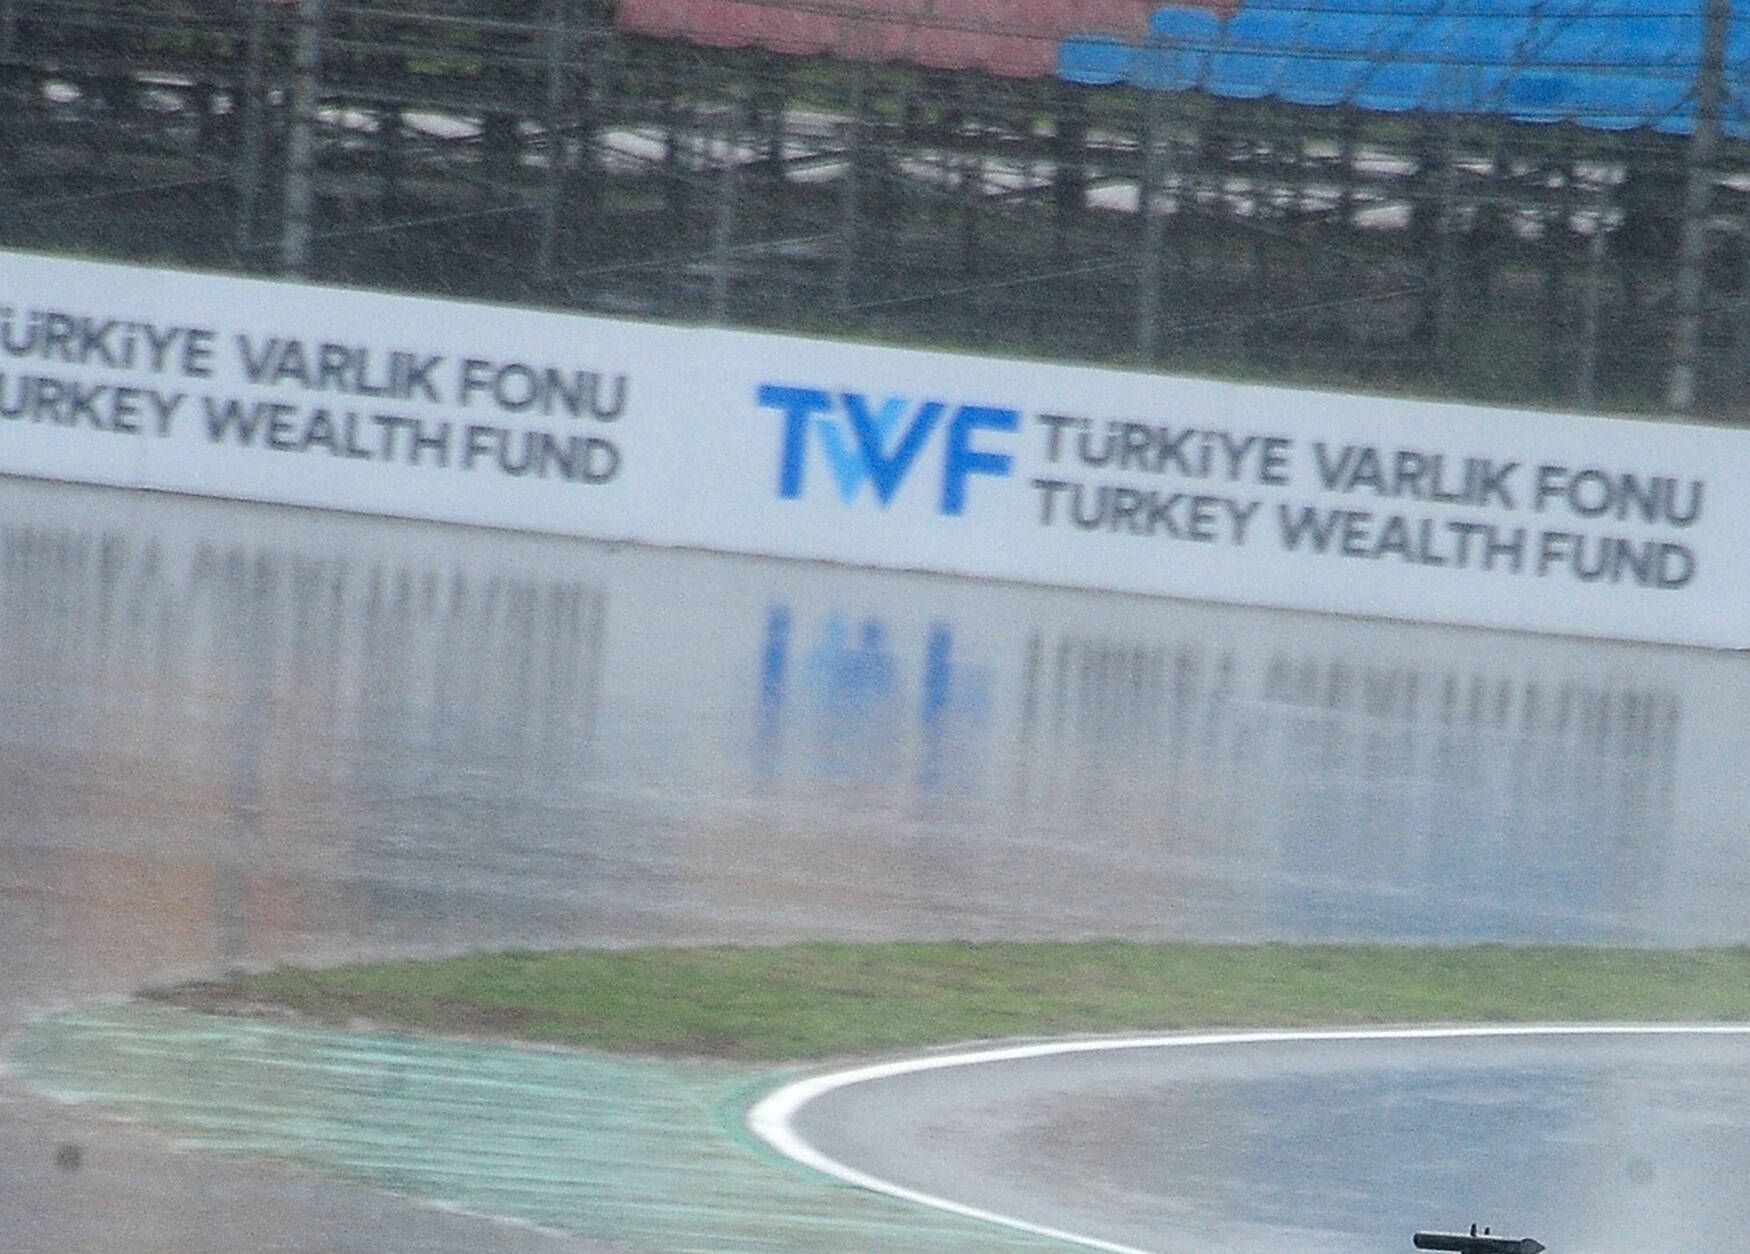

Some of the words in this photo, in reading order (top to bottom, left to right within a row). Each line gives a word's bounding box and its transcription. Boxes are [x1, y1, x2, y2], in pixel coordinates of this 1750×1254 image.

[0, 371, 186, 437] URKEY
[202, 396, 450, 468] WEALTH
[463, 425, 621, 486] FUND
[236, 333, 444, 403] VARLIK
[459, 358, 627, 423] FONU
[1032, 478, 1261, 546] TURKEY
[1278, 503, 1525, 574] WEALTH
[1537, 530, 1696, 590] FUND
[1313, 441, 1520, 510] VARLIK
[1535, 464, 1704, 528] FONU
